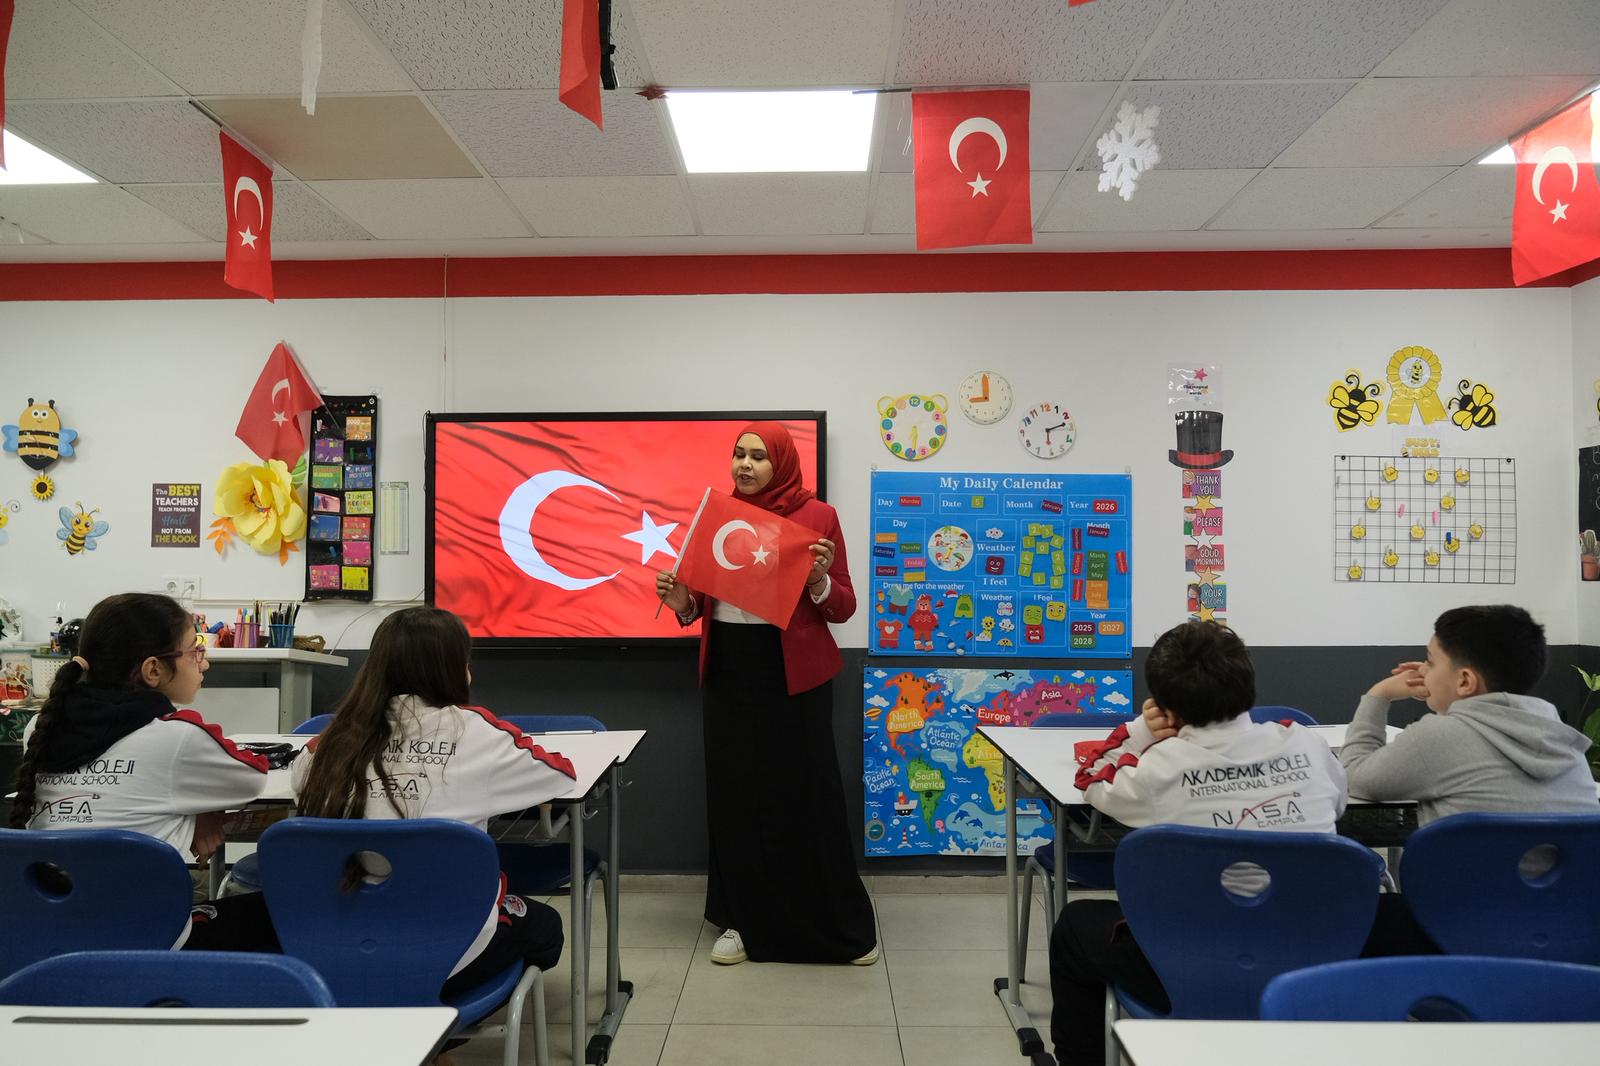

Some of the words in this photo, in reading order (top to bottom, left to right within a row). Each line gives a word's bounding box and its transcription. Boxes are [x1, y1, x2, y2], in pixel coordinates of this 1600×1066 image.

[1040, 403, 1051, 412] 12
[1054, 406, 1058, 414] 1
[1030, 409, 1038, 418] 11
[1062, 412, 1070, 420] 2
[1022, 416, 1032, 427] 10
[1068, 422, 1074, 432] 3
[1020, 428, 1026, 437] 9
[1066, 434, 1072, 443] 4
[1026, 440, 1032, 448] 8
[1059, 444, 1065, 452] 5
[1035, 446, 1040, 455] 7
[1050, 448, 1054, 456] 6
[940, 477, 960, 490] My
[964, 478, 998, 490] Daily
[1003, 478, 1064, 490] Calendar
[1196, 476, 1219, 484] THANK
[168, 484, 200, 496] BEST
[1200, 486, 1215, 495] YOU
[156, 498, 199, 506] TEACHERS
[878, 498, 894, 508] Day
[1006, 500, 1034, 508] Month
[1070, 501, 1088, 509] Year
[1042, 502, 1062, 512] February
[892, 520, 908, 528] Day
[1196, 518, 1222, 527] PLEASE
[154, 534, 170, 544] THE
[172, 534, 198, 544] BOOK
[874, 548, 895, 556] Saturday
[976, 543, 1016, 552] Weather
[1200, 548, 1219, 558] GOOD
[1091, 562, 1104, 570] April
[878, 567, 896, 575] Sunday
[1092, 572, 1104, 580] May
[1203, 588, 1223, 598] YOUR
[1090, 612, 1106, 620] Year
[1041, 690, 1062, 700] Asia
[892, 710, 918, 720] North
[978, 708, 1012, 723] Europe
[890, 720, 923, 729] America
[928, 728, 960, 740] Atlantic
[930, 736, 955, 748] Ocean
[406, 755, 446, 765] SCHOOL
[86, 760, 135, 774] KOLEJI
[865, 768, 892, 785] Pacific
[915, 772, 940, 780] South
[1181, 762, 1266, 788] AKADEMIK
[36, 775, 77, 785] NATIONAL
[80, 775, 120, 785] SCHOOL
[911, 780, 945, 788] America
[1190, 779, 1268, 798] INTERNATIONAL
[1270, 770, 1310, 786] SCHOOL
[870, 778, 895, 793] Ocean
[1212, 801, 1302, 827] NASA
[1257, 815, 1306, 828] CAMPUS
[980, 839, 1028, 850] Antarca
